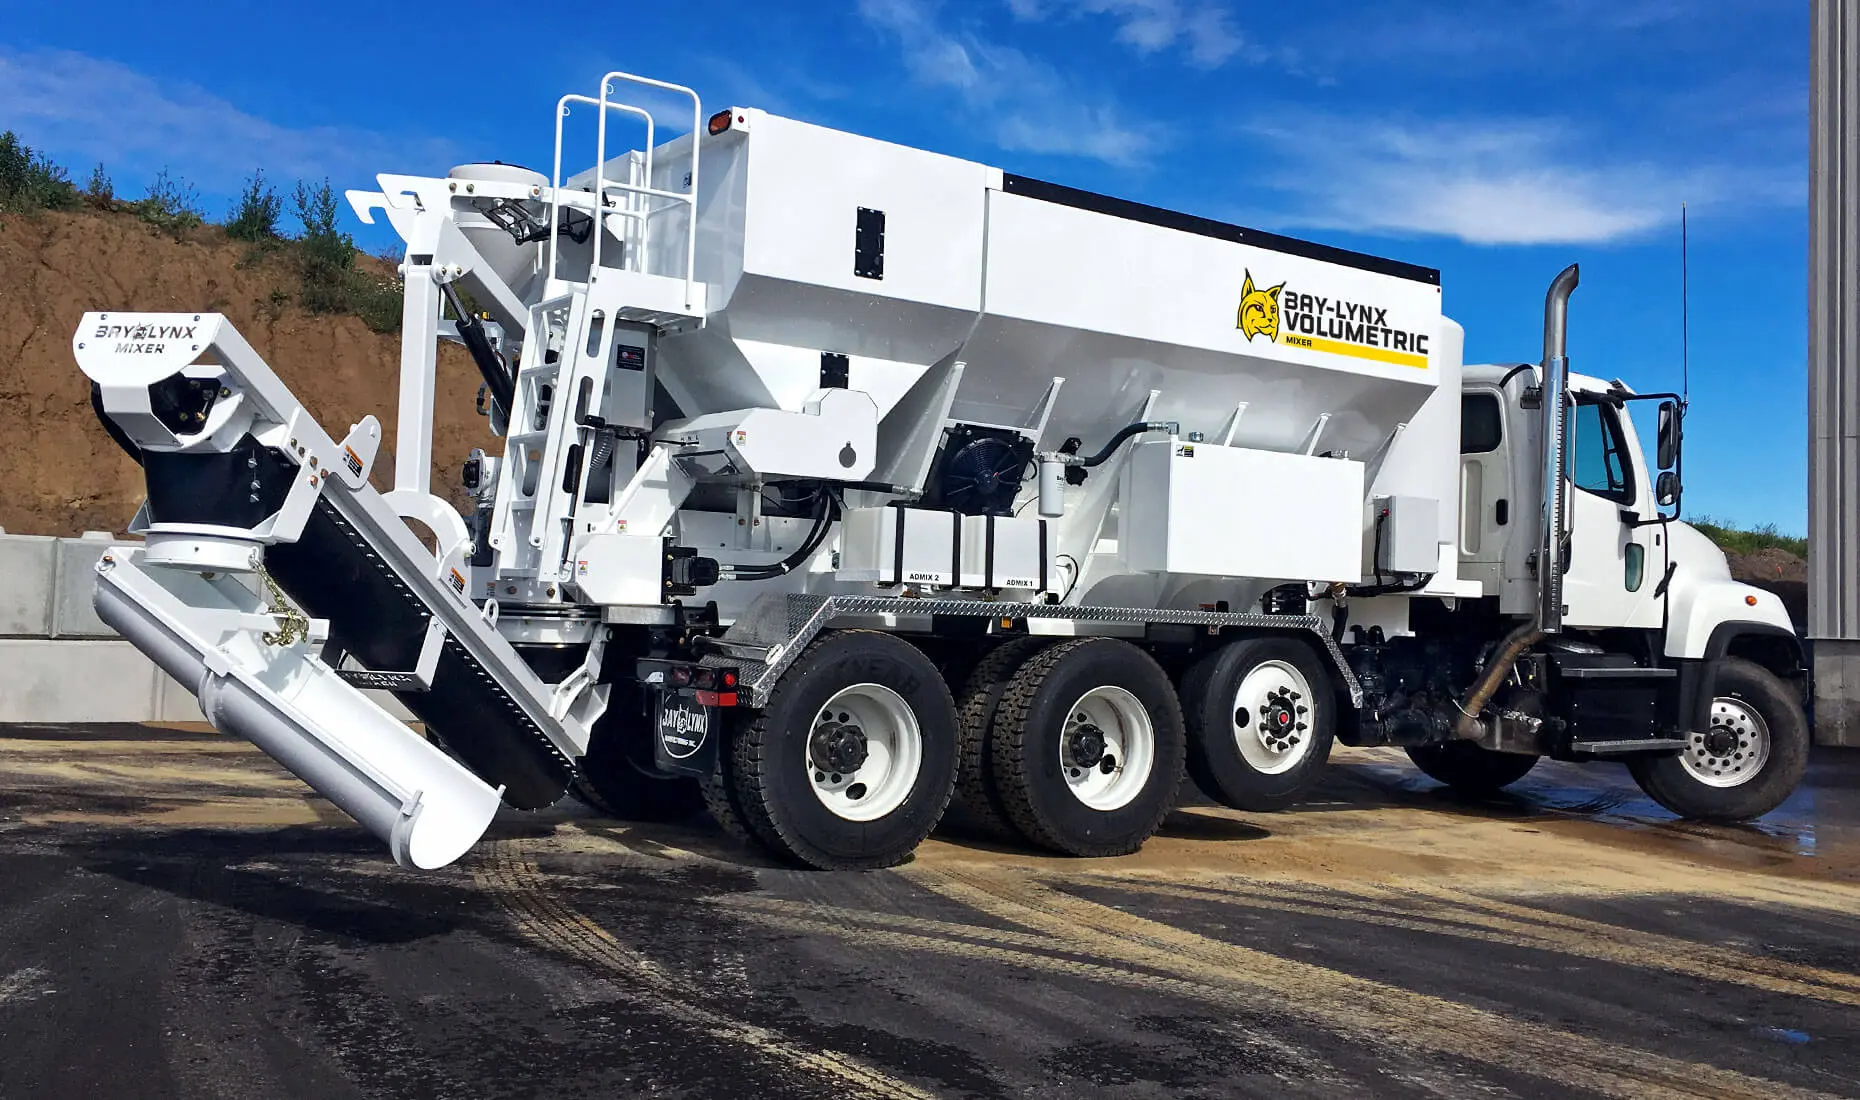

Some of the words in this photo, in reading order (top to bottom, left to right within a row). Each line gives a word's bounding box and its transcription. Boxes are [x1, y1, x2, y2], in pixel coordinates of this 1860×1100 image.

[1284, 291, 1388, 327] BAY-LYNX
[95, 325, 135, 338] BAY
[148, 326, 197, 339] LYNX
[1284, 310, 1429, 355] VOLUMETRIC
[1286, 335, 1312, 347] MIXER
[114, 343, 165, 354] MIXER
[909, 573, 933, 581] ADMIX
[1006, 579, 1028, 587] ADMIX
[687, 713, 705, 733] LYNX
